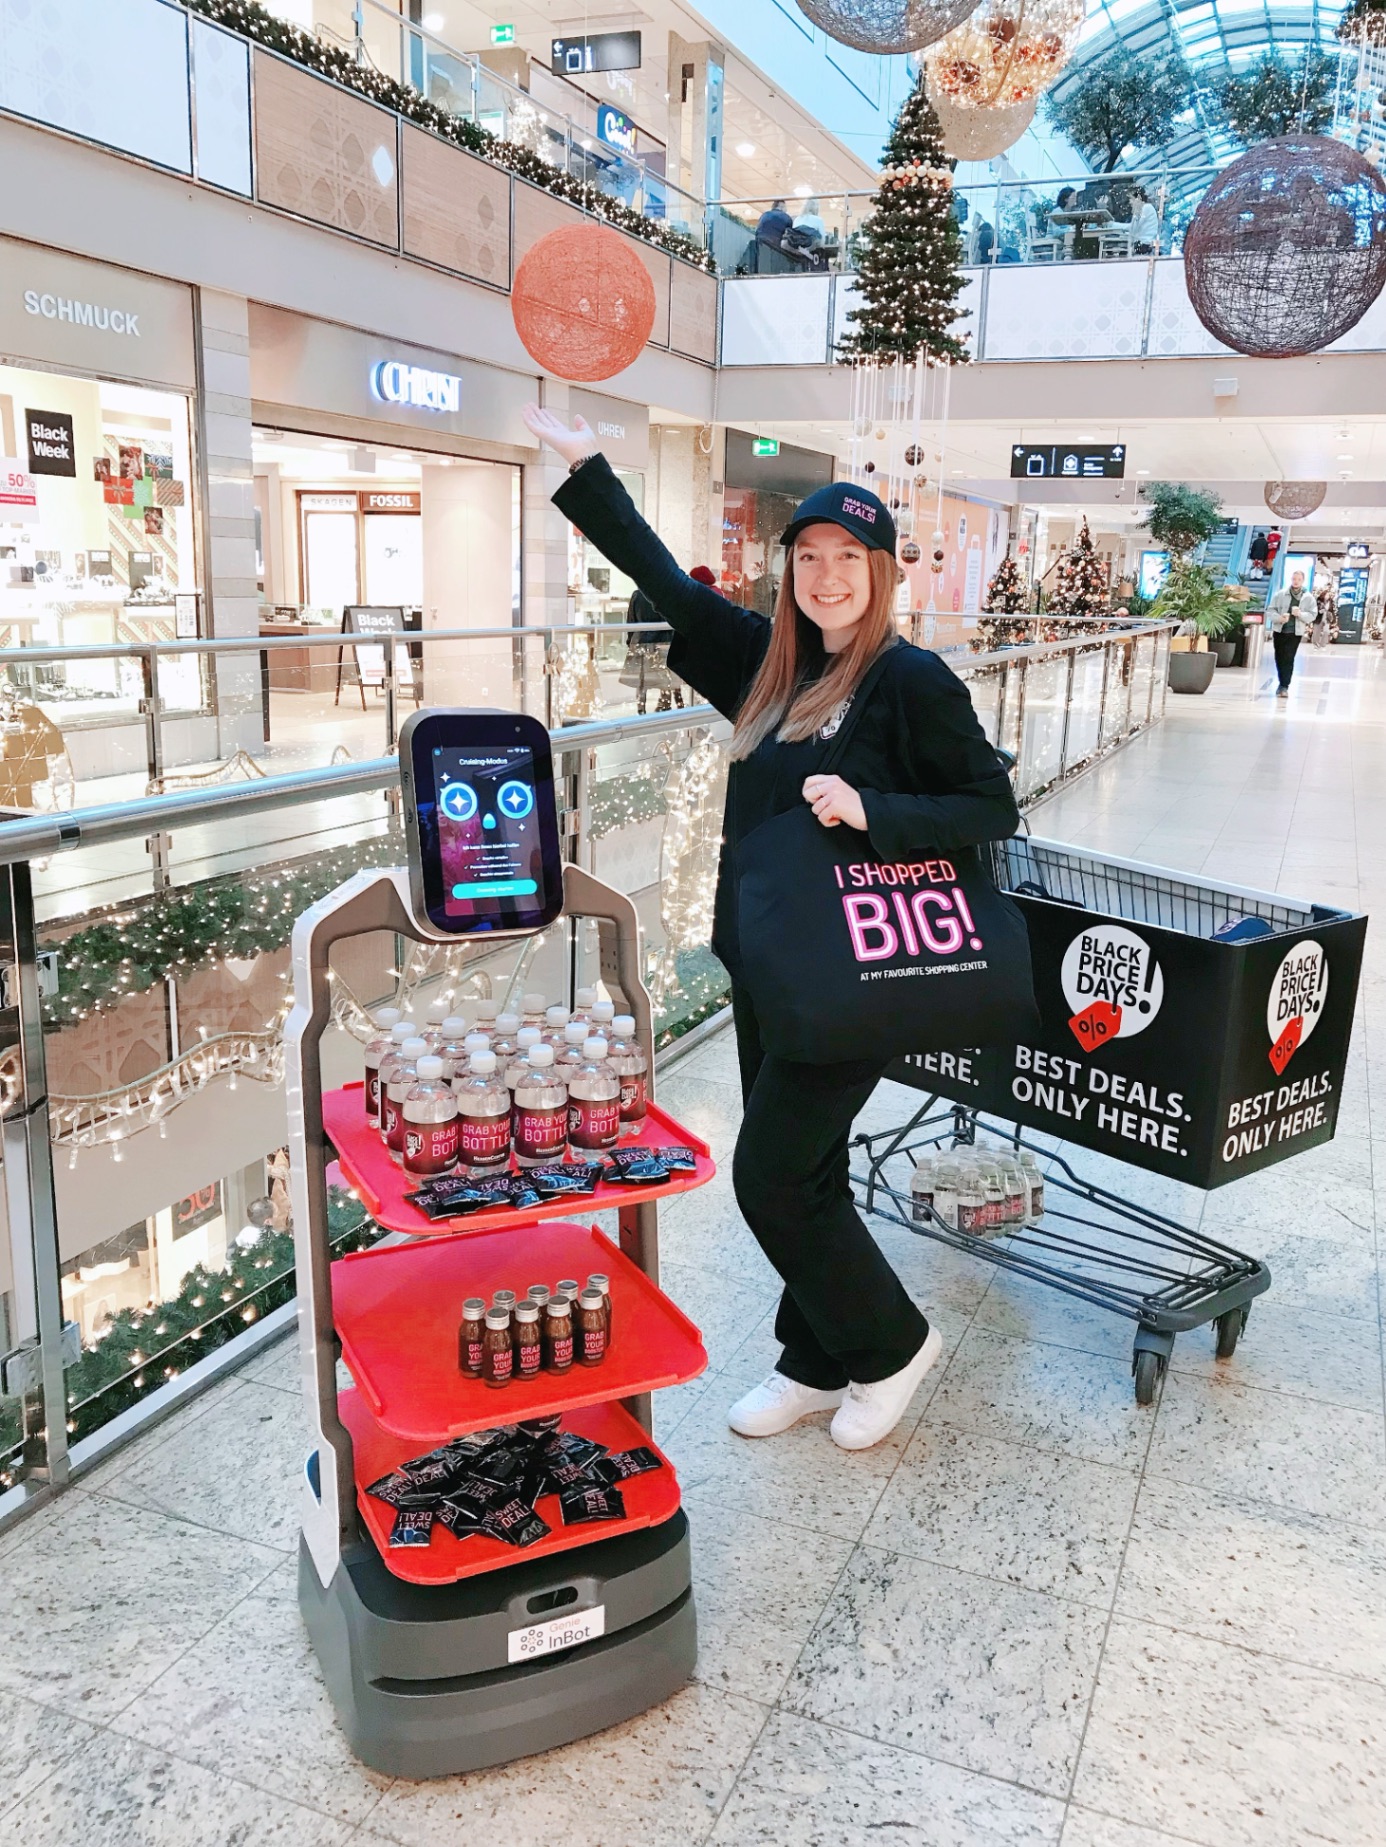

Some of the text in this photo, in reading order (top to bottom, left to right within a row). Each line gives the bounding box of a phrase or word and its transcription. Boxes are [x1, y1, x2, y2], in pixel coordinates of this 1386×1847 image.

[24, 290, 141, 337] SCHMUCK
[370, 361, 462, 412] CHRIST
[31, 422, 69, 442] Black
[598, 421, 625, 439] UHREN
[32, 441, 70, 460] Week
[8, 473, 36, 488] 50%
[369, 495, 413, 507] FOSSIL
[844, 496, 877, 515] GRAB YOUR
[842, 502, 877, 524] DEALS!
[357, 614, 396, 626] Black
[834, 859, 957, 889] I SHOPPED
[842, 887, 983, 962] BIG!
[1081, 935, 1142, 966] BLACK
[860, 960, 988, 981] AT MY FAVOURITE SHOPPING CENTER
[1079, 952, 1141, 986] PRICE
[1282, 954, 1318, 978] BLACK
[1280, 971, 1317, 998] PRICE
[1014, 1044, 1193, 1122] BEST DEALS.
[1227, 1070, 1333, 1129] BEST DEALS.
[524, 1116, 552, 1127] GRAB
[590, 1106, 615, 1119] GRAB
[1012, 1076, 1188, 1156] ONLY HERE.
[432, 1126, 456, 1142] GRAB
[462, 1123, 490, 1135] GRAB
[590, 1115, 618, 1133] BOTT
[1222, 1101, 1328, 1163] ONLY HERE.
[432, 1136, 459, 1157] BOT
[468, 1344, 482, 1352] GR
[468, 1352, 482, 1360] YO
[399, 1511, 433, 1522] DEAL!
[495, 1498, 522, 1519] SWEET
[501, 1504, 531, 1528] DEAL!
[397, 1521, 431, 1531] SWEET
[549, 1617, 581, 1632] Genie
[549, 1626, 591, 1649] InBot
